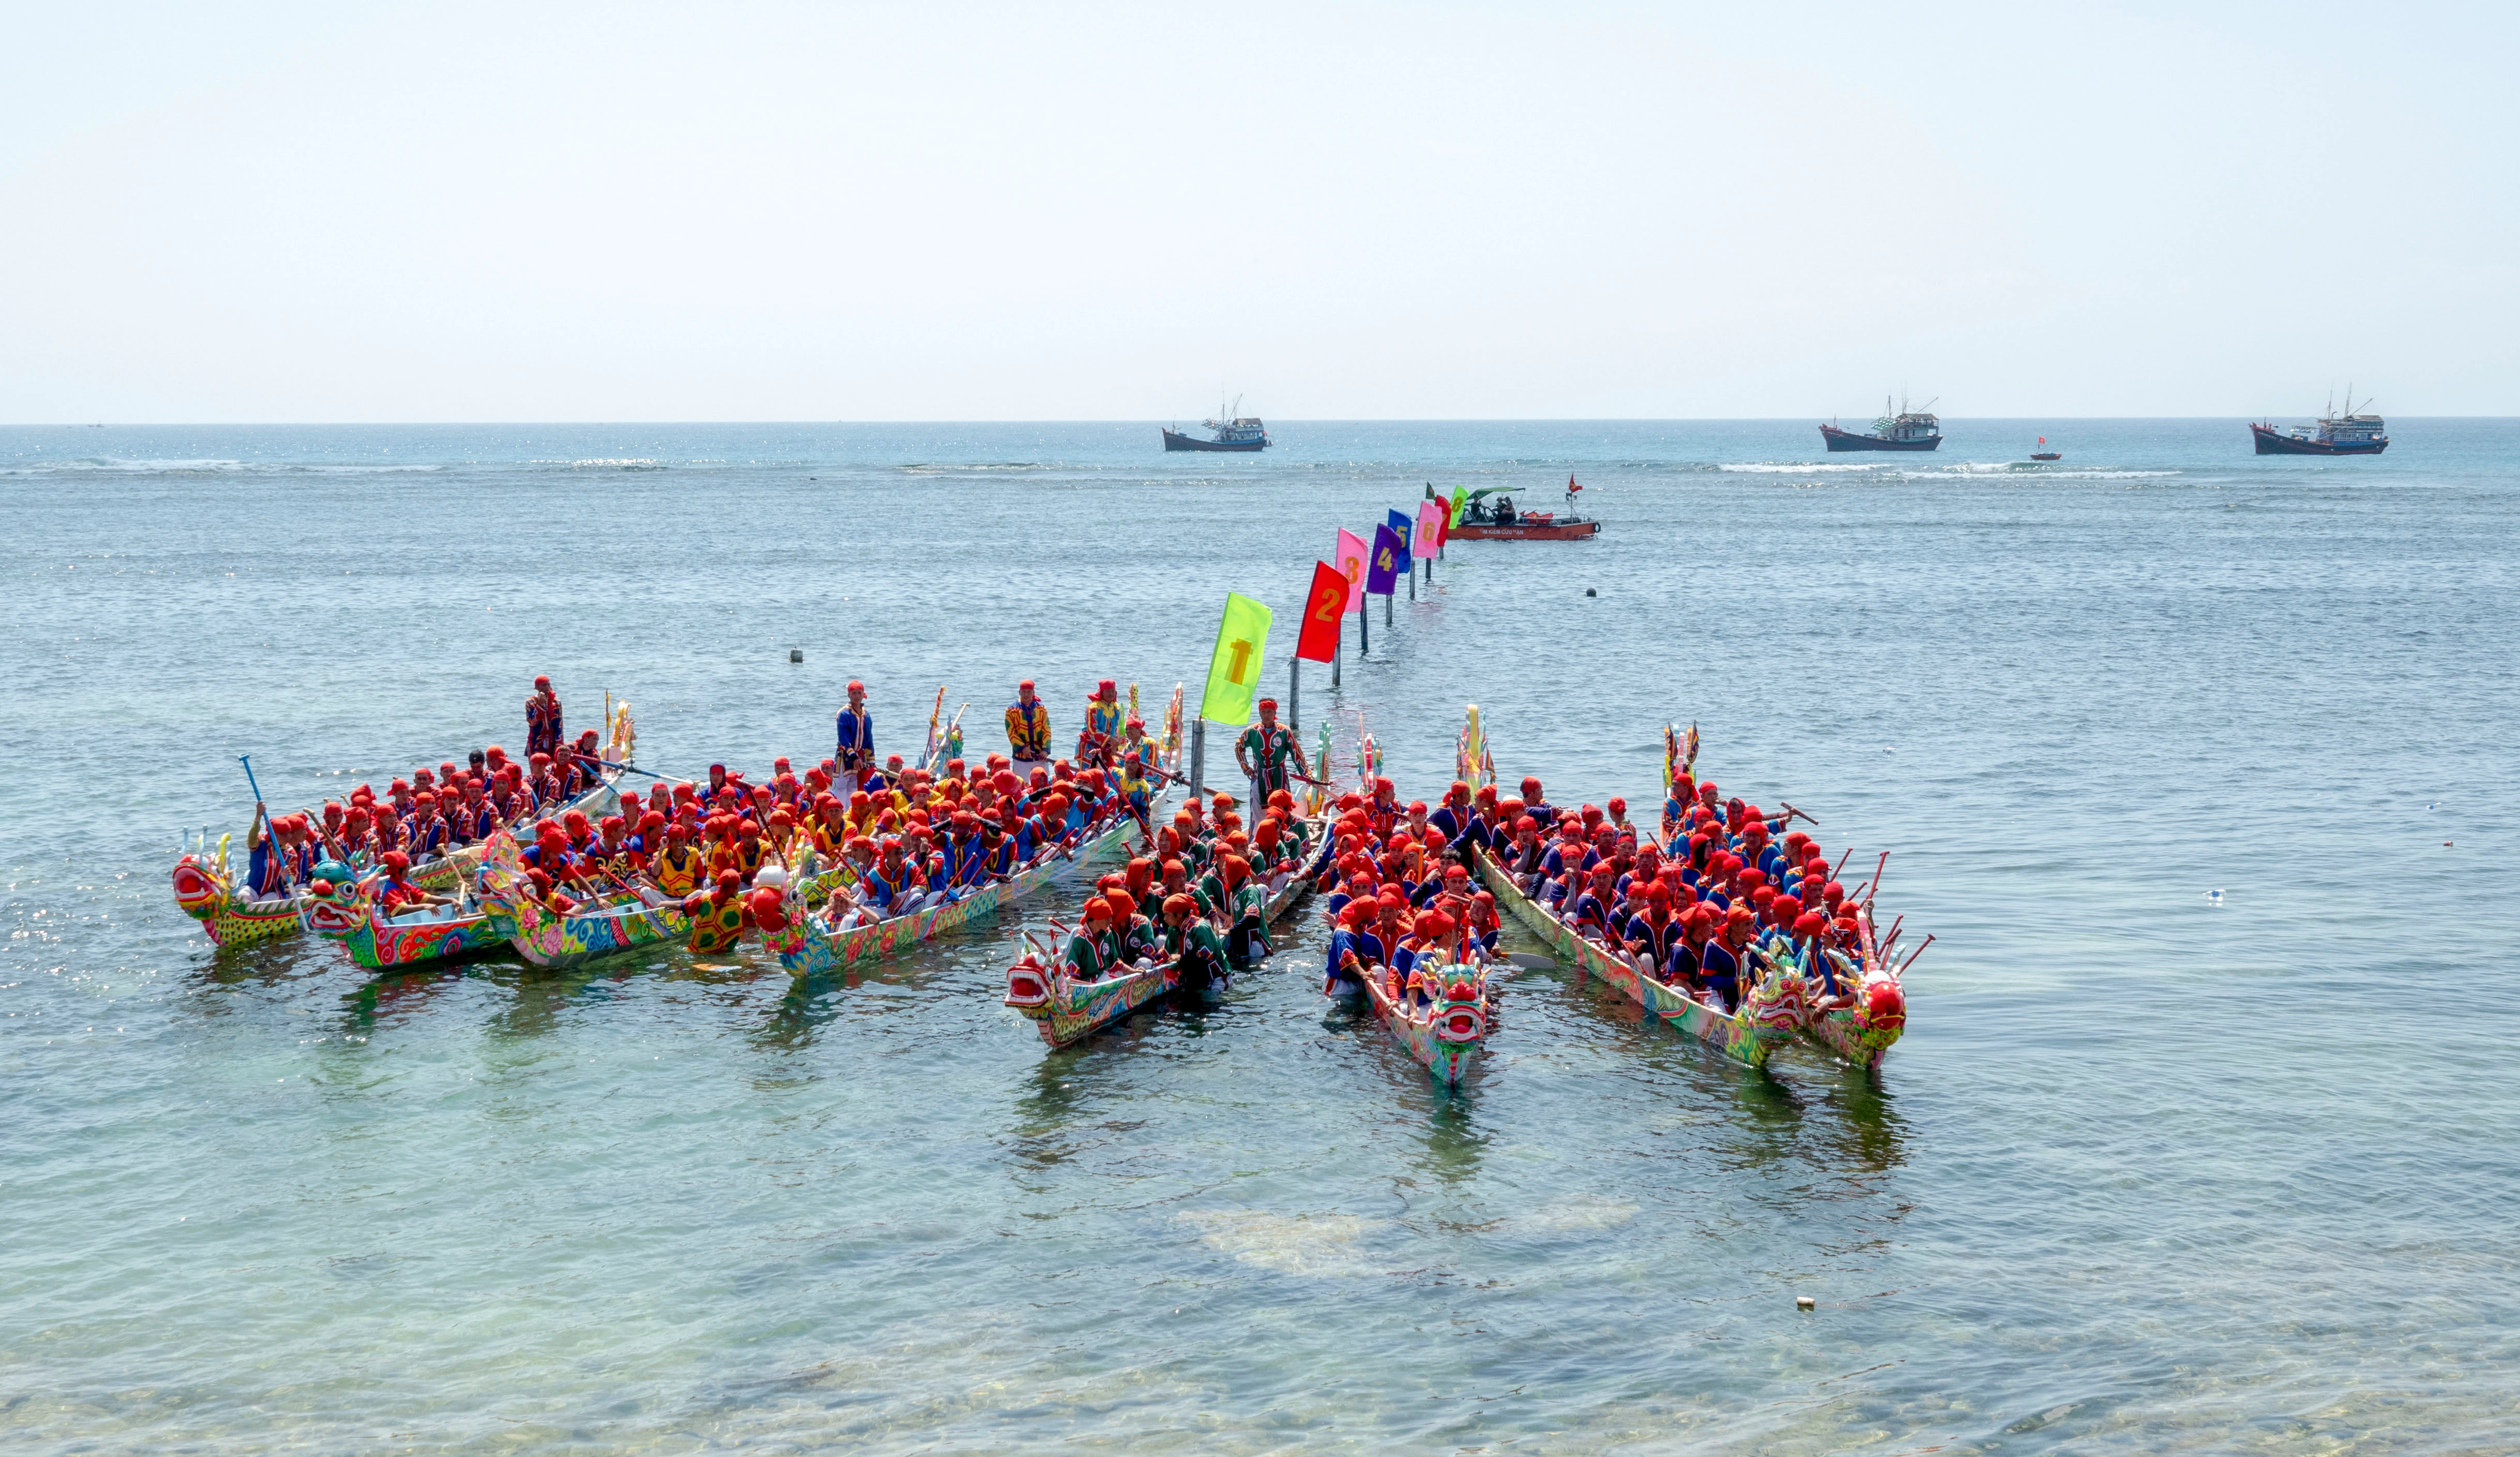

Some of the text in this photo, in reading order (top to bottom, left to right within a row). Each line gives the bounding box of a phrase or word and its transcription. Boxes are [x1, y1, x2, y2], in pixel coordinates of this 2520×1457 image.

[1451, 496, 1463, 513] 8
[1396, 525, 1408, 548] 5
[1422, 522, 1435, 541] 6
[1345, 556, 1359, 584] 3
[1377, 547, 1392, 572] 4
[1315, 588, 1340, 622] 2
[1224, 638, 1253, 686] 1
